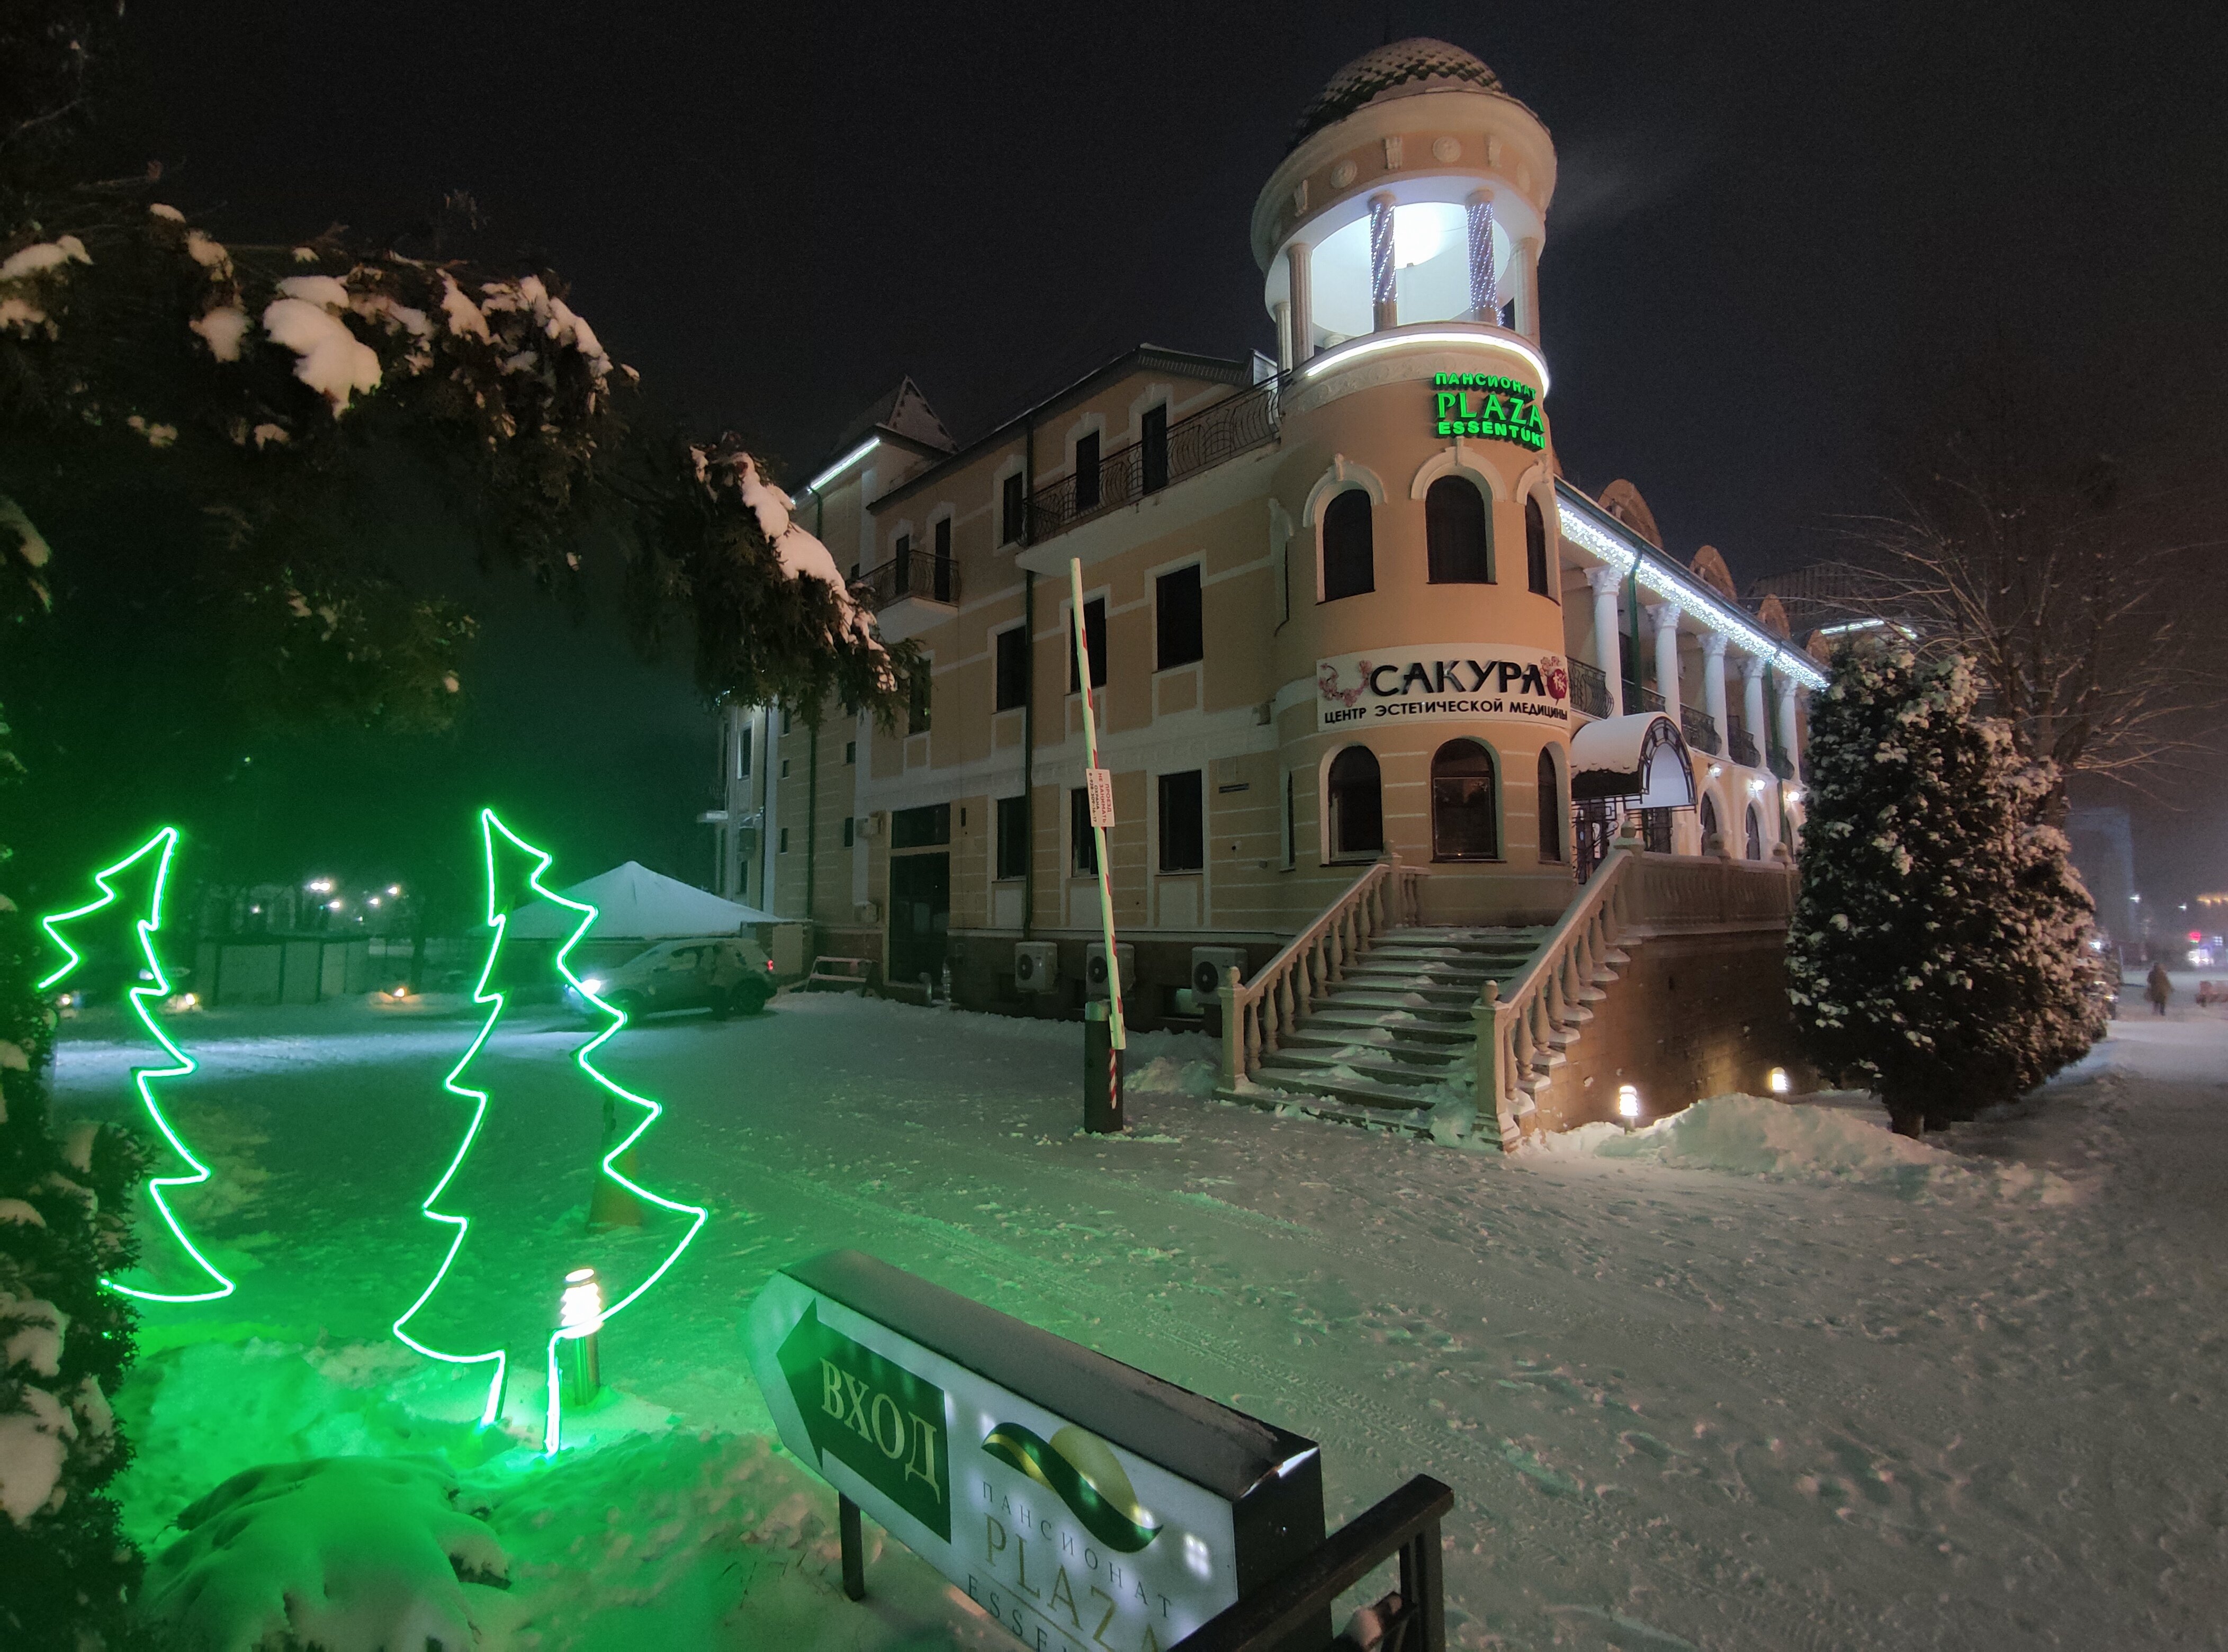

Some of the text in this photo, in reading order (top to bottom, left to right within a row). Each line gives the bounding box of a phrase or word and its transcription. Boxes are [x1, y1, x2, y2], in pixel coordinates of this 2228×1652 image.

[1435, 372, 1535, 399] ПАНСИОНАТ
[1436, 392, 1544, 432] PLAZA
[1438, 421, 1545, 449] ESSENTUKI
[1369, 659, 1547, 697] САКУРА
[1324, 698, 1568, 724] ЦЕНТР ЭСТЕТИЧЕСКОЙ МЕДИЦИНЫ
[1098, 773, 1103, 782] НЕ
[820, 1357, 940, 1504] ВХОД
[983, 1482, 1171, 1618] ПАНСИОНАТ
